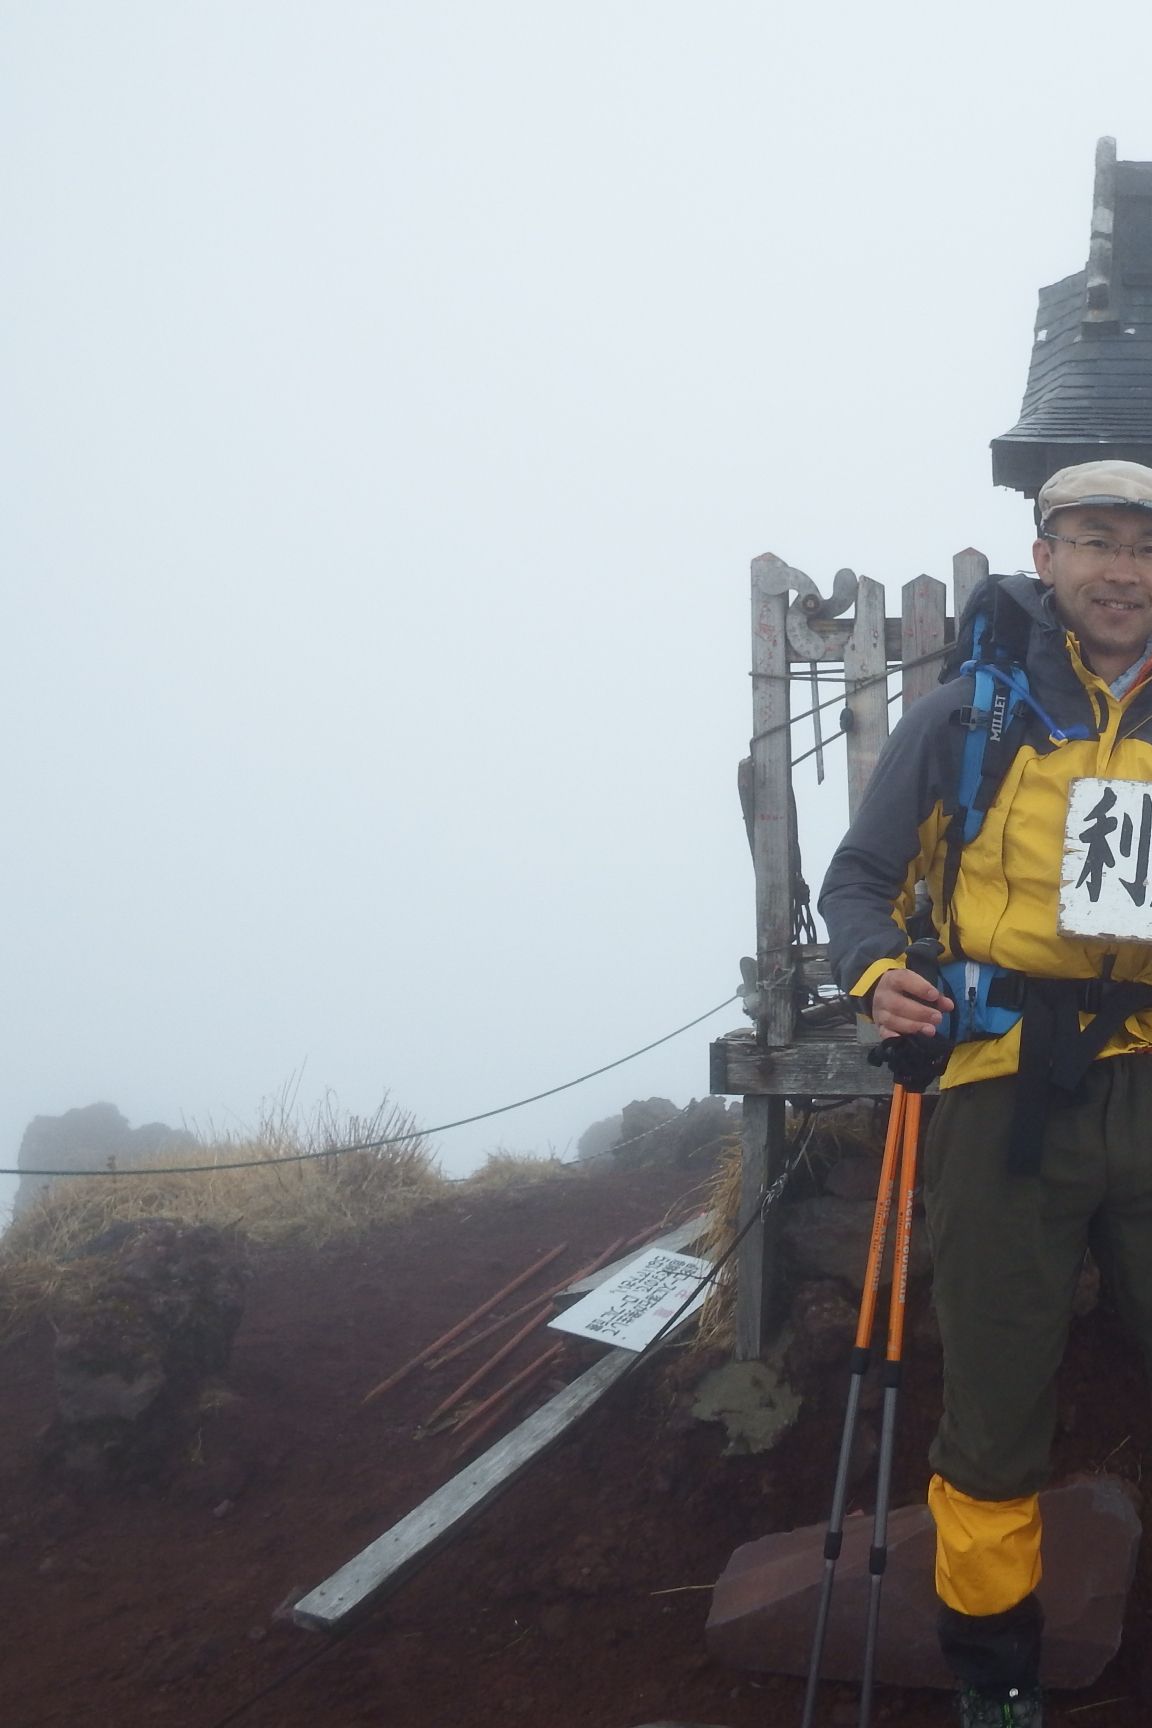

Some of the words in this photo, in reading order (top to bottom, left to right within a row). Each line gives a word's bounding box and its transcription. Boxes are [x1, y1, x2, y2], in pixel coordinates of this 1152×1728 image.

[990, 695, 1006, 742] MILLET
[905, 1189, 914, 1230] MAGIC
[899, 1235, 910, 1304] MOUNTAIN
